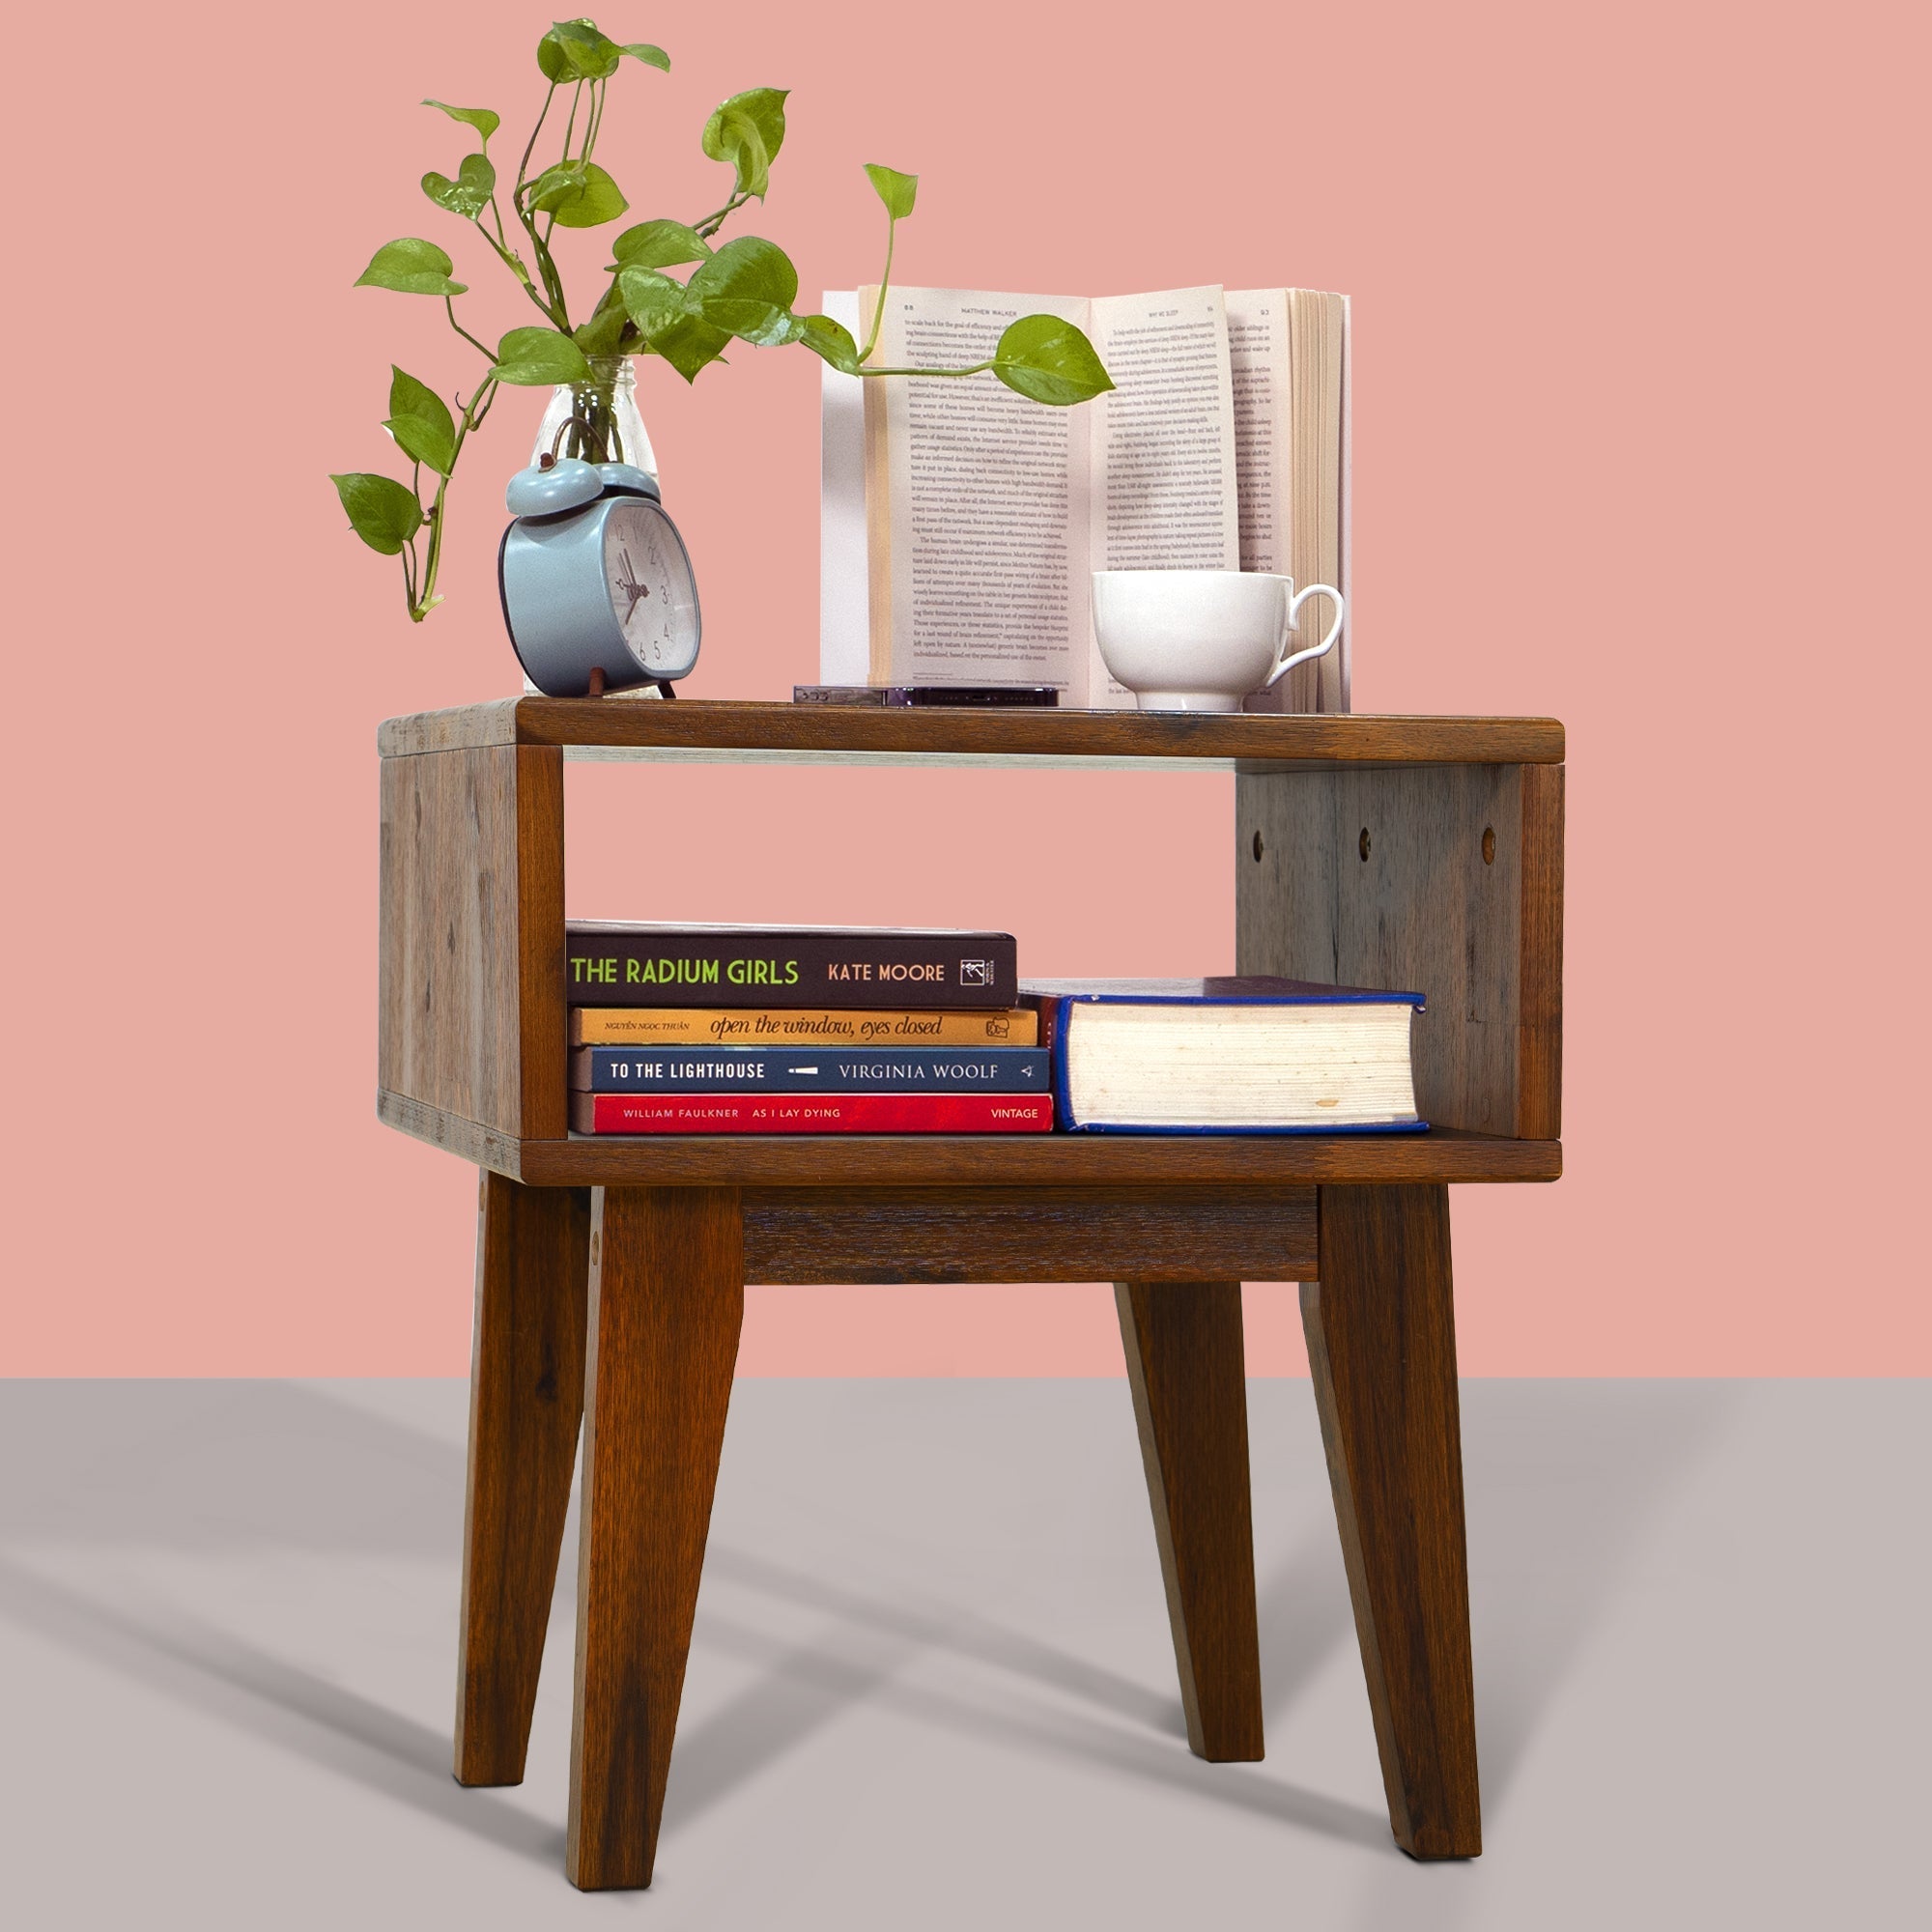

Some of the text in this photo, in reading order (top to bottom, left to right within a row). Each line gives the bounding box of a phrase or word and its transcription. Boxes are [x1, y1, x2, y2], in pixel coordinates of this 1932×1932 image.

[614, 524, 625, 541] 12
[648, 546, 656, 565] 2
[661, 584, 668, 605] 3
[664, 623, 669, 638] 4
[639, 641, 646, 661] 6
[654, 640, 661, 660] 5
[570, 957, 799, 984] THE RADIUM GIRLS
[828, 964, 945, 981] KATE MOORE
[710, 1015, 943, 1040] open the window, eyes closed
[611, 1063, 765, 1078] TO THE LIGHTHOUSE
[838, 1065, 998, 1079] VIRGINIA WOOLF
[623, 1109, 739, 1118] WILLIAM FAULKNER
[752, 1108, 840, 1118] AS I LAY DYING
[990, 1108, 1038, 1119] VINTAGE
